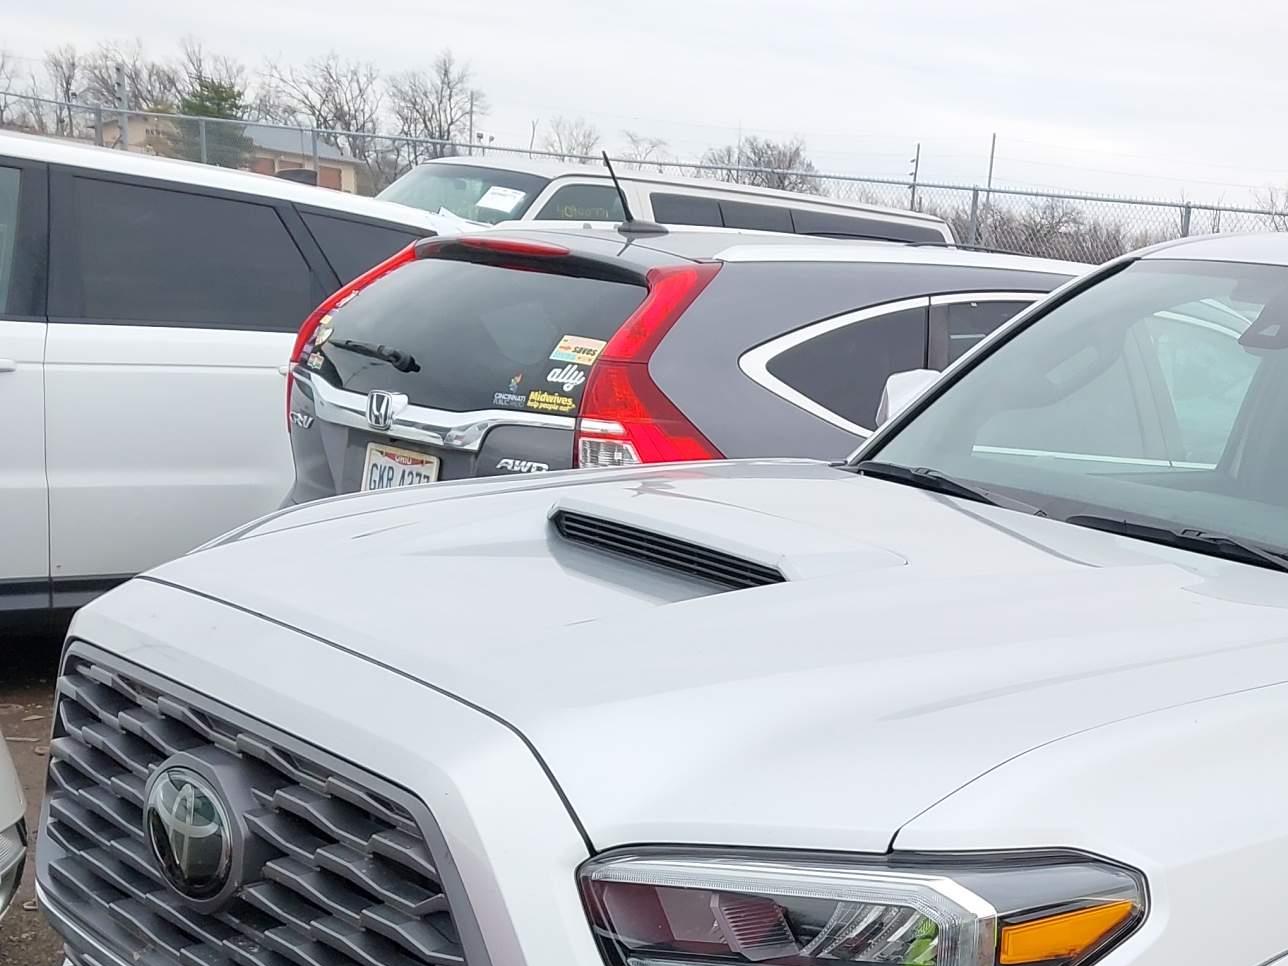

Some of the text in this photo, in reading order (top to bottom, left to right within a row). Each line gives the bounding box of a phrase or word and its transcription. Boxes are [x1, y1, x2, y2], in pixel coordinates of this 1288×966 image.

[547, 364, 585, 392] ally
[369, 463, 395, 490] GKR
[496, 458, 550, 473] AWD
